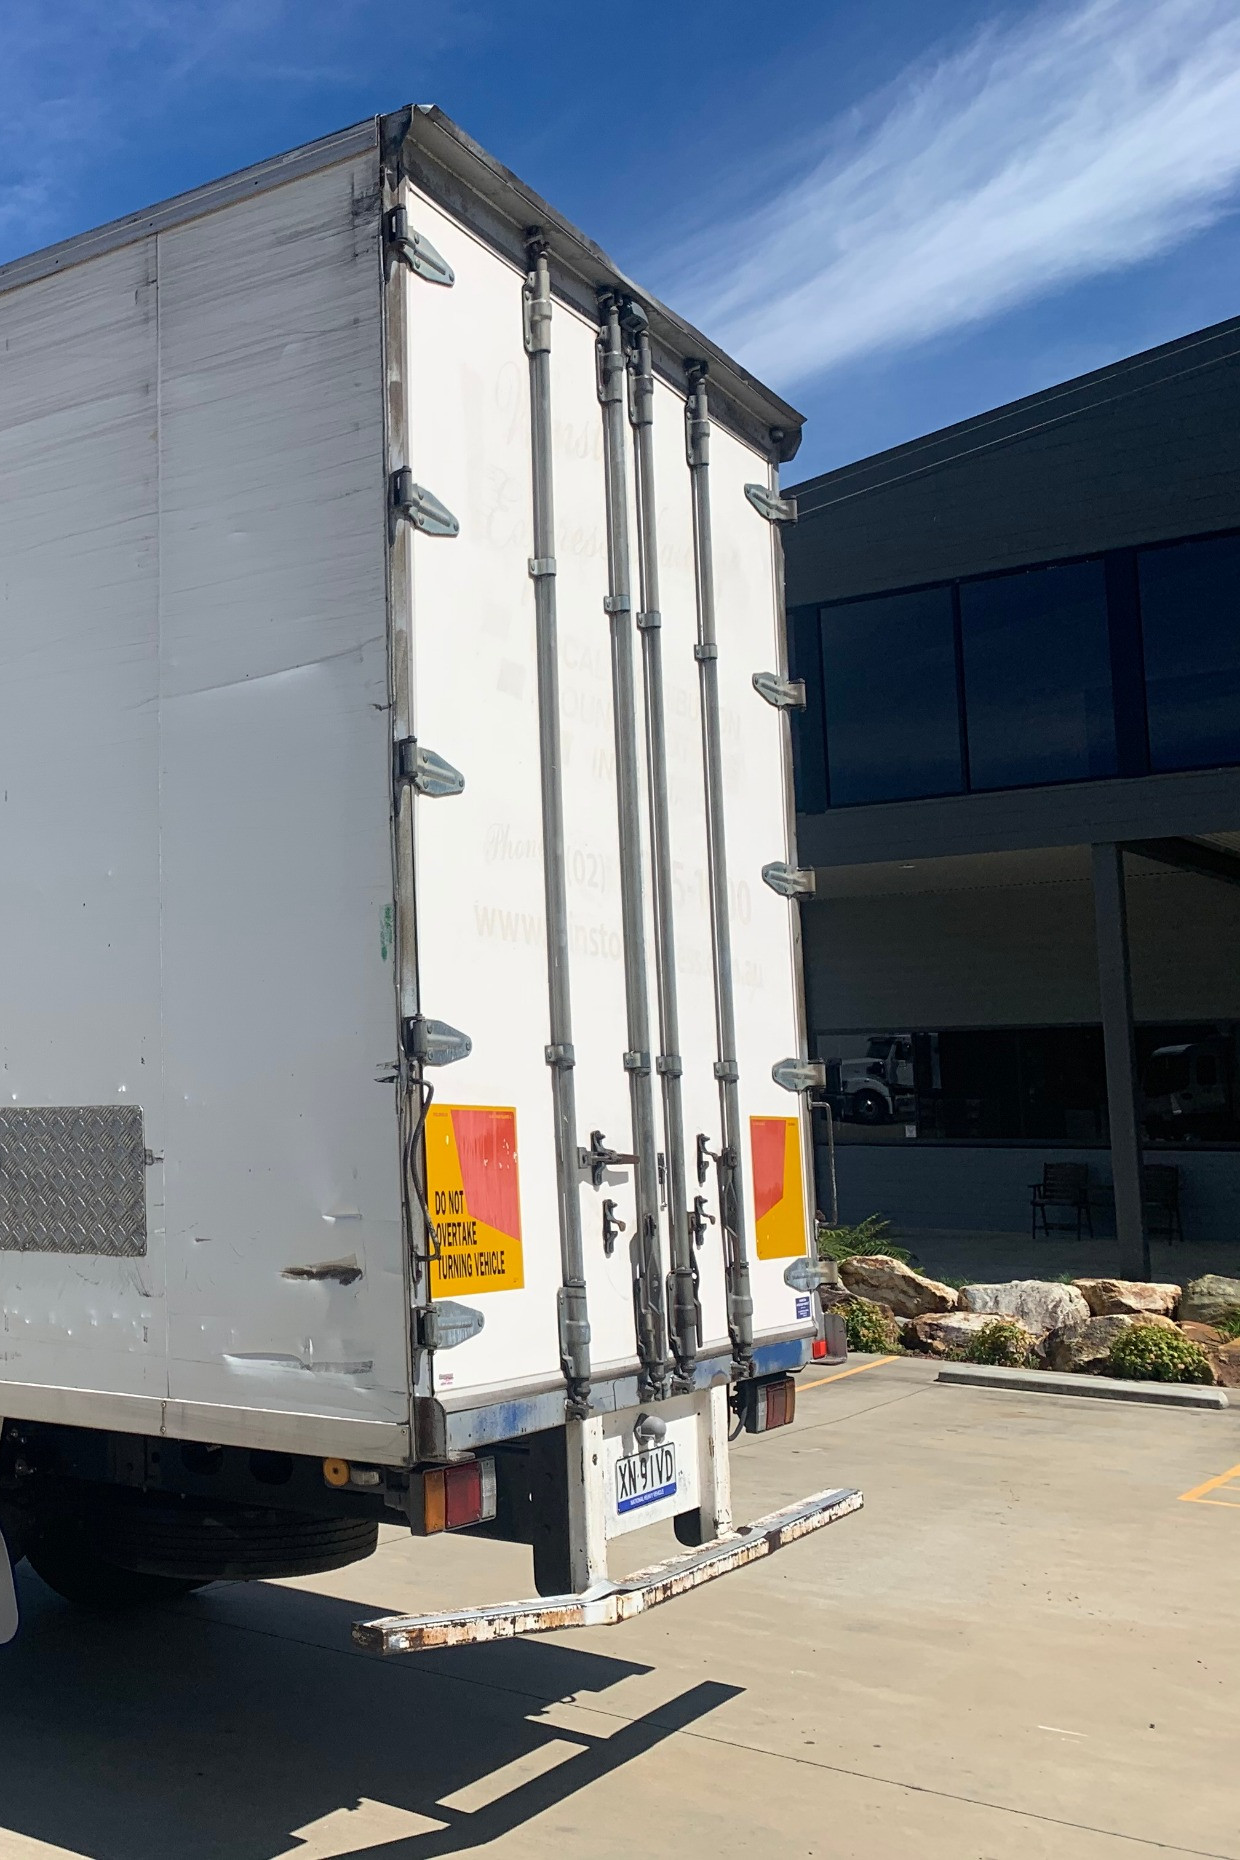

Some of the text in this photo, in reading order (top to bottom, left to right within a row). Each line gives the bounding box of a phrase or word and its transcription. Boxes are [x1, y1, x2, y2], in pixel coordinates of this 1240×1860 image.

[435, 1190, 464, 1216] DO NOT
[436, 1221, 478, 1248] OVERTAKE
[438, 1250, 506, 1281] TURNING VEHICLE
